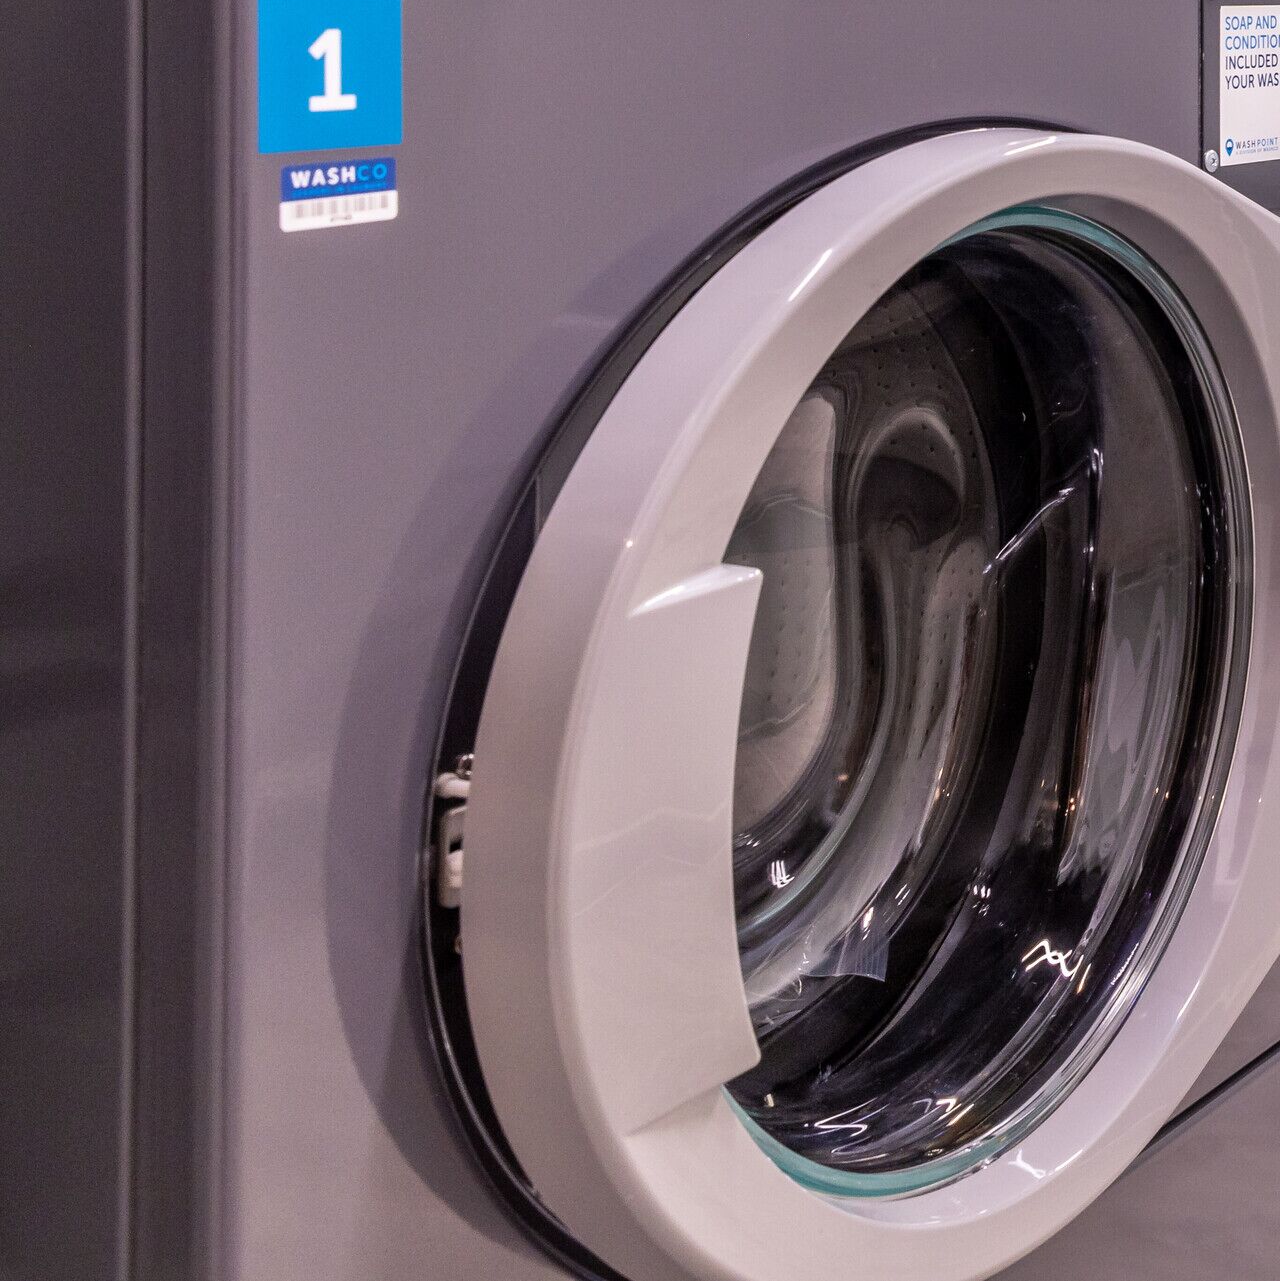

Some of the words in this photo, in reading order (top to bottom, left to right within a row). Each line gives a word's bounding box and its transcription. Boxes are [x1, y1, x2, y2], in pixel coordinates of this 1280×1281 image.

[1225, 16, 1253, 31] SOAP
[1255, 15, 1277, 29] AND
[1225, 53, 1278, 70] INCLUDED
[308, 28, 357, 112] 1
[1225, 74, 1255, 90] YOUR
[1235, 137, 1278, 149] WASHPOINT
[290, 163, 387, 189] WASHCO
